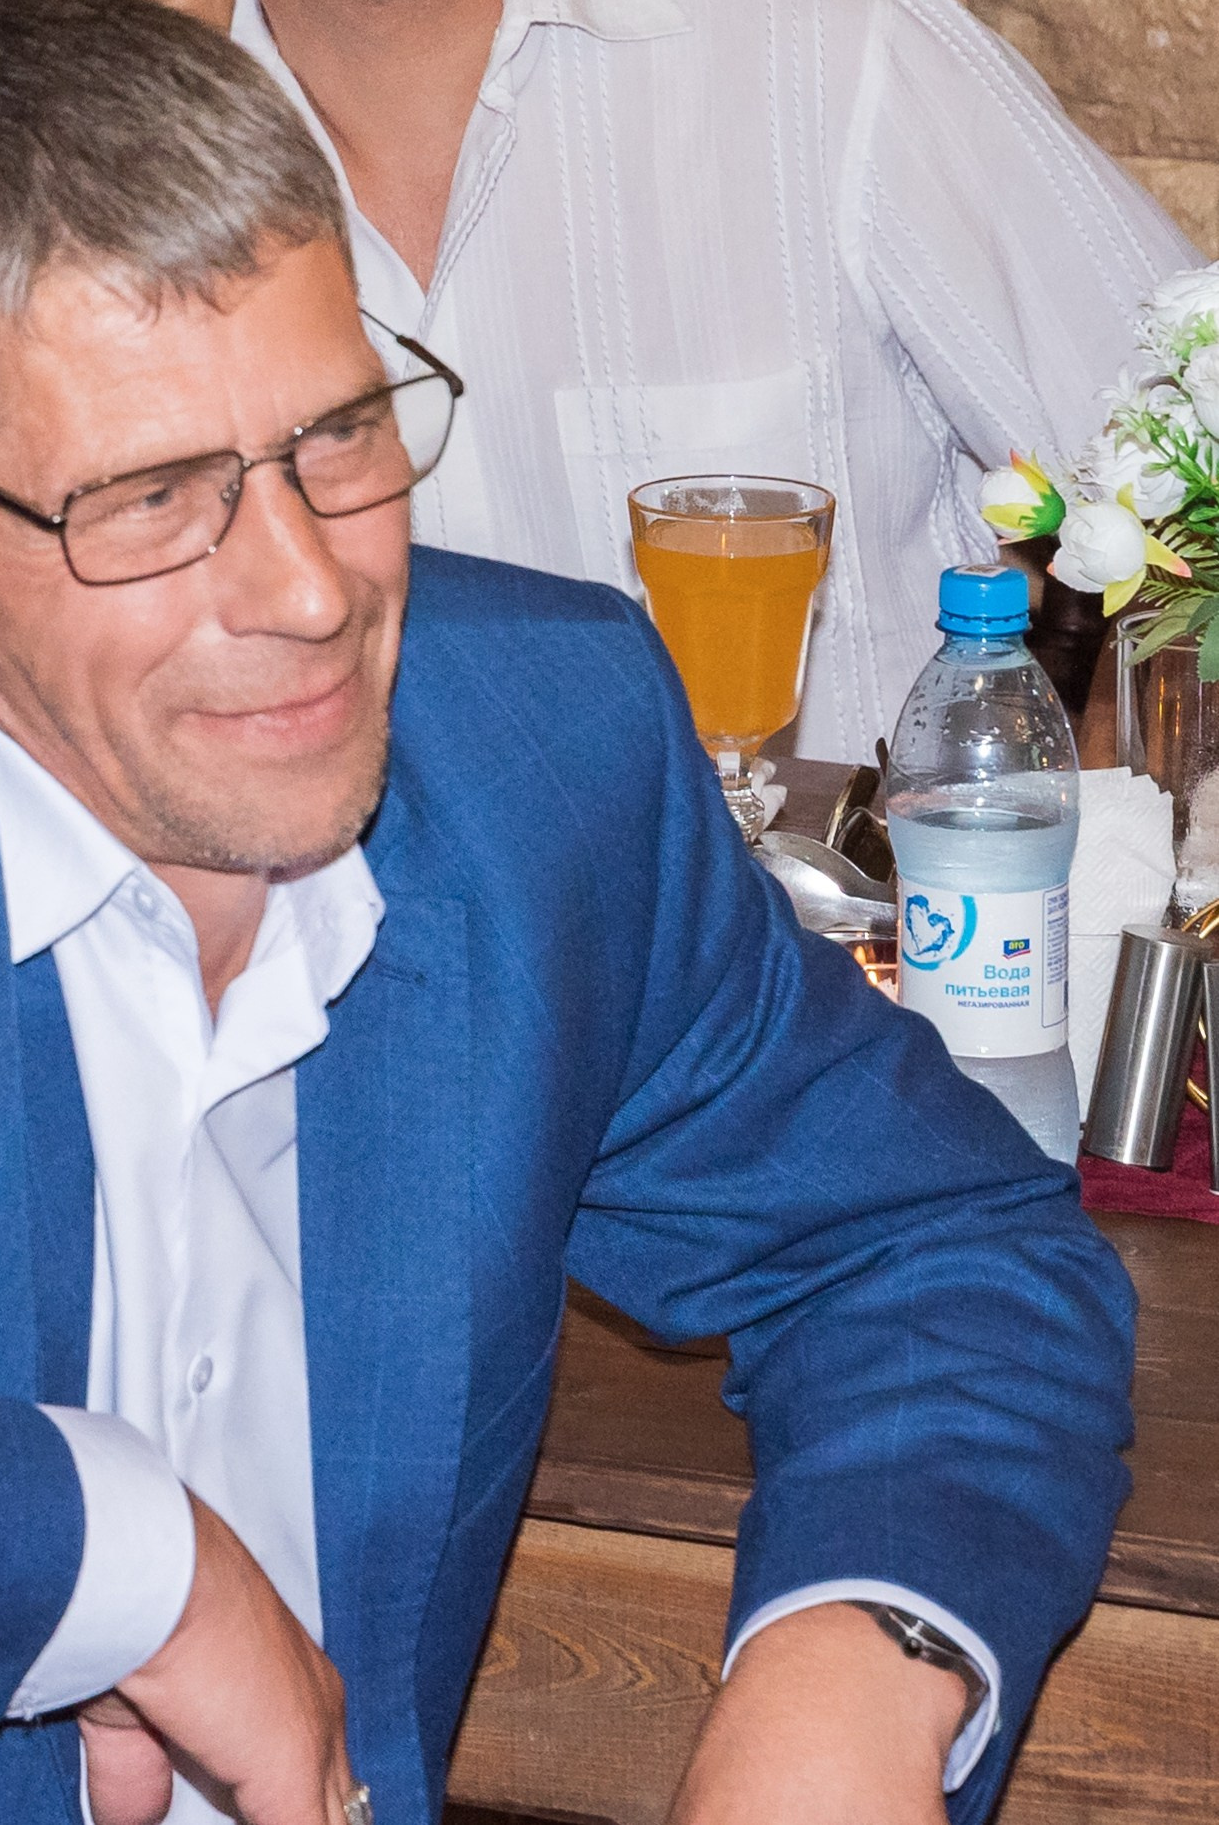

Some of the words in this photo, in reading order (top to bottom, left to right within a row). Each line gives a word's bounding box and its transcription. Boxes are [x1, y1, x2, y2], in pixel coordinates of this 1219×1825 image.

[1008, 940, 1025, 950] aro
[983, 964, 1030, 980] Вода
[945, 983, 1030, 998] питьевая
[957, 1000, 1030, 1009] НЕГАЗИРОВАННАЯ
